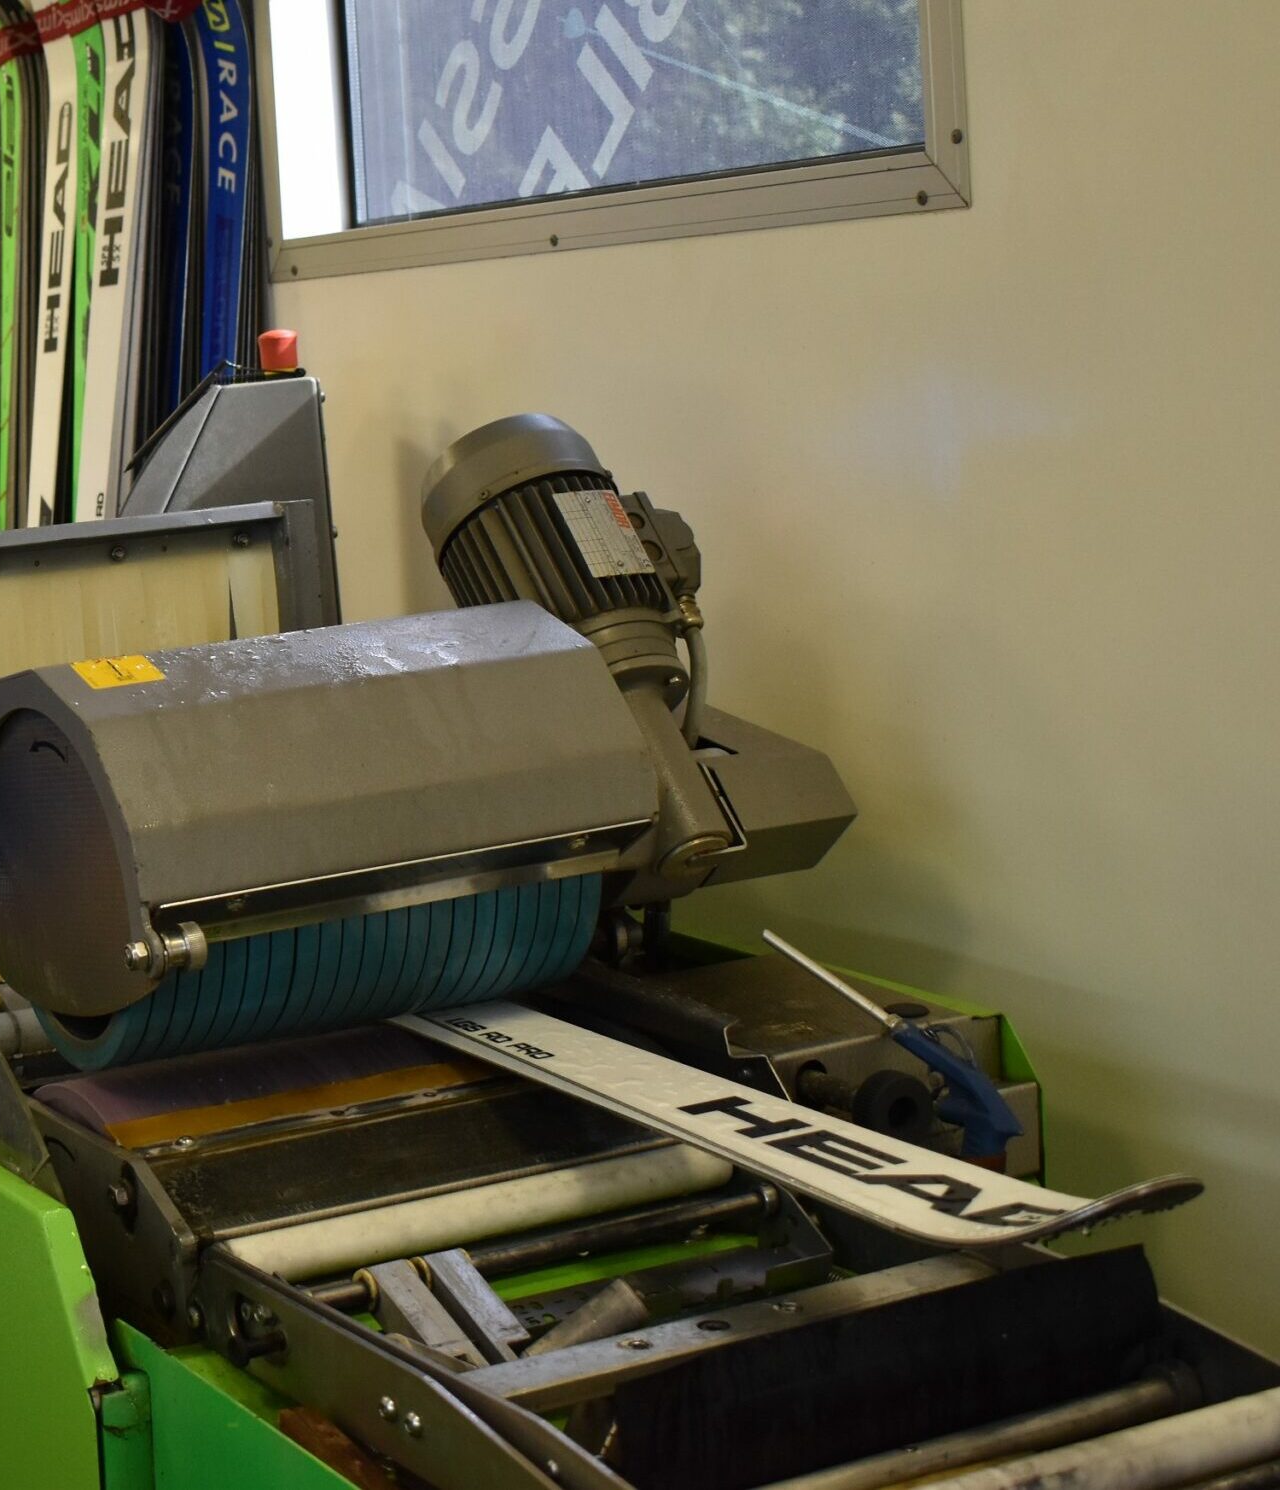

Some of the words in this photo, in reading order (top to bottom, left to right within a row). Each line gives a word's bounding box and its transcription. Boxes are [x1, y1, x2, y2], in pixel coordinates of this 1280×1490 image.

[44, 101, 73, 353] HEAD
[99, 13, 136, 287] HEAD
[505, 1042, 556, 1060] PRO
